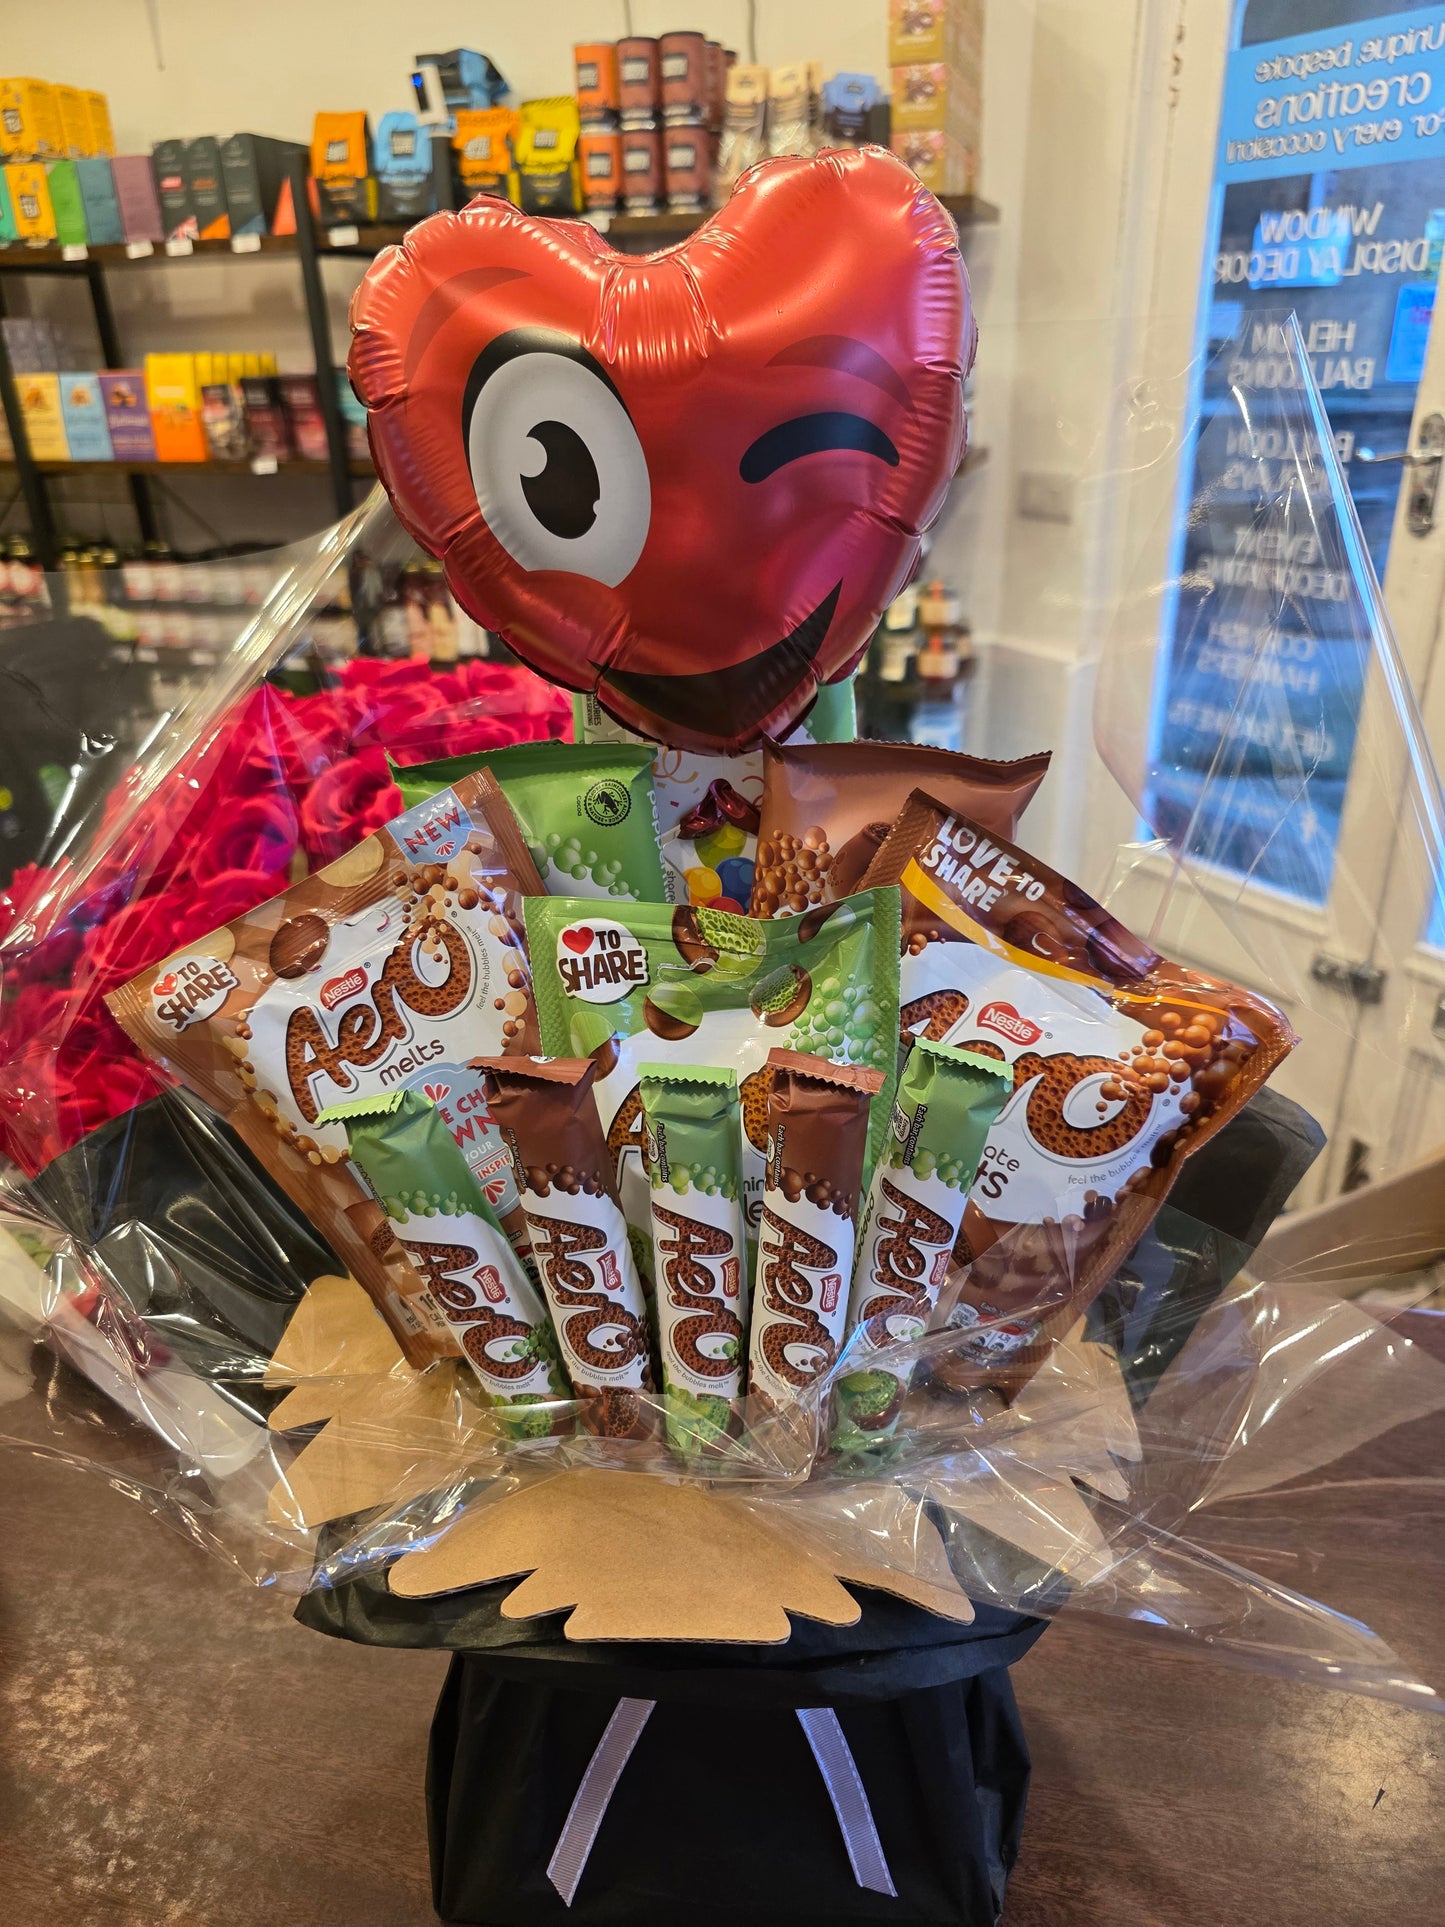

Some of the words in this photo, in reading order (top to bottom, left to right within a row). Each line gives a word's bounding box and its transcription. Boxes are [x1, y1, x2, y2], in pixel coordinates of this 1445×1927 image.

[403, 806, 461, 856] NEW
[936, 816, 1021, 884] LOVE
[1014, 872, 1046, 902] TO
[922, 843, 1003, 914] SHARE
[594, 928, 622, 951] TO
[176, 960, 201, 982] TO
[480, 947, 491, 980] bubbles
[558, 948, 646, 994] SHARE
[156, 963, 235, 1030] SHARE
[475, 994, 487, 1010] feel
[481, 981, 490, 996] the
[285, 914, 478, 1125] Aero
[378, 1037, 446, 1087] melts
[915, 1103, 928, 1122] Each
[777, 1124, 787, 1141] Each
[911, 1121, 925, 1137] bar
[775, 1140, 785, 1155] bar
[903, 1136, 919, 1166] contains
[773, 1155, 783, 1187] contains
[1067, 1174, 1087, 1185] feel
[1089, 1172, 1107, 1184] the
[863, 1172, 956, 1352] Aero
[526, 1212, 639, 1370] Aero
[650, 1200, 744, 1378] Aero
[761, 1200, 838, 1389] Aero
[400, 1239, 540, 1380] Aero
[580, 1368, 608, 1382] bubbles
[681, 1371, 707, 1388] bubbles
